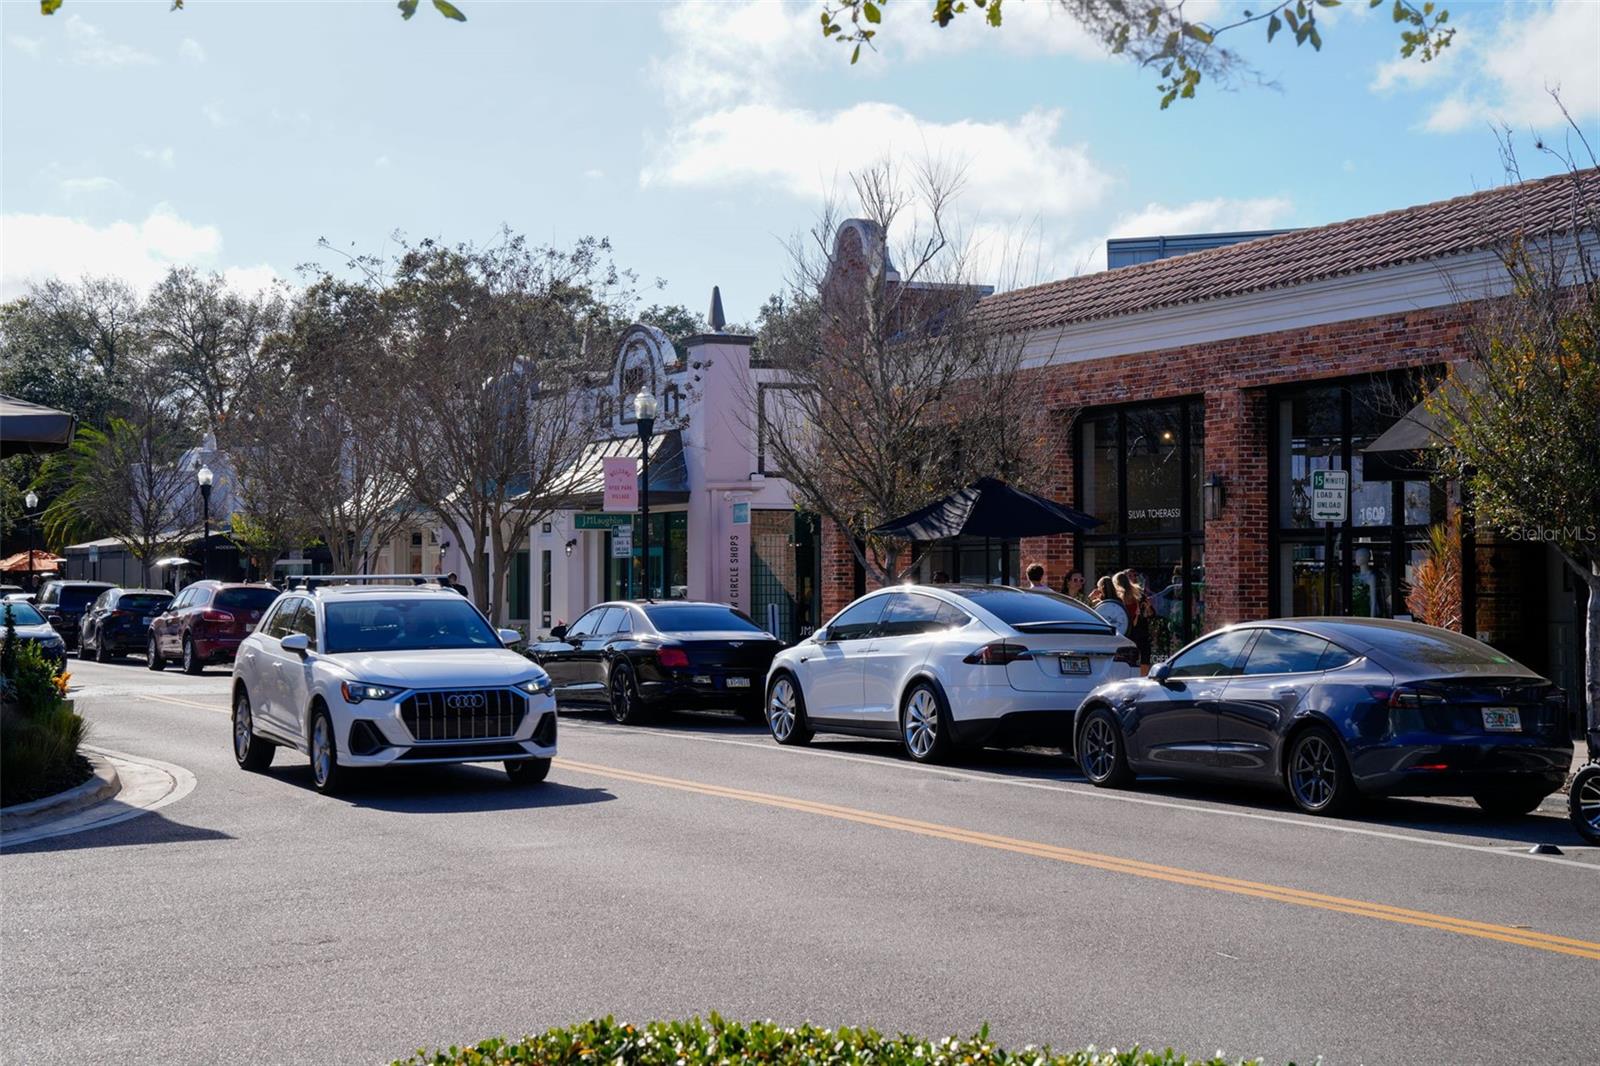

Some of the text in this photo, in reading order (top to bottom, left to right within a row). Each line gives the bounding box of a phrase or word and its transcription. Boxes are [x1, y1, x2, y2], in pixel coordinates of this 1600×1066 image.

[1315, 475, 1345, 486] 15 MINUTE
[1316, 491, 1333, 499] LOAD
[1316, 501, 1342, 509] UNLOAD
[1127, 507, 1182, 520] SILVIA TCHERASSI
[729, 535, 739, 564] SHOPS
[729, 567, 739, 598] CIRCLE
